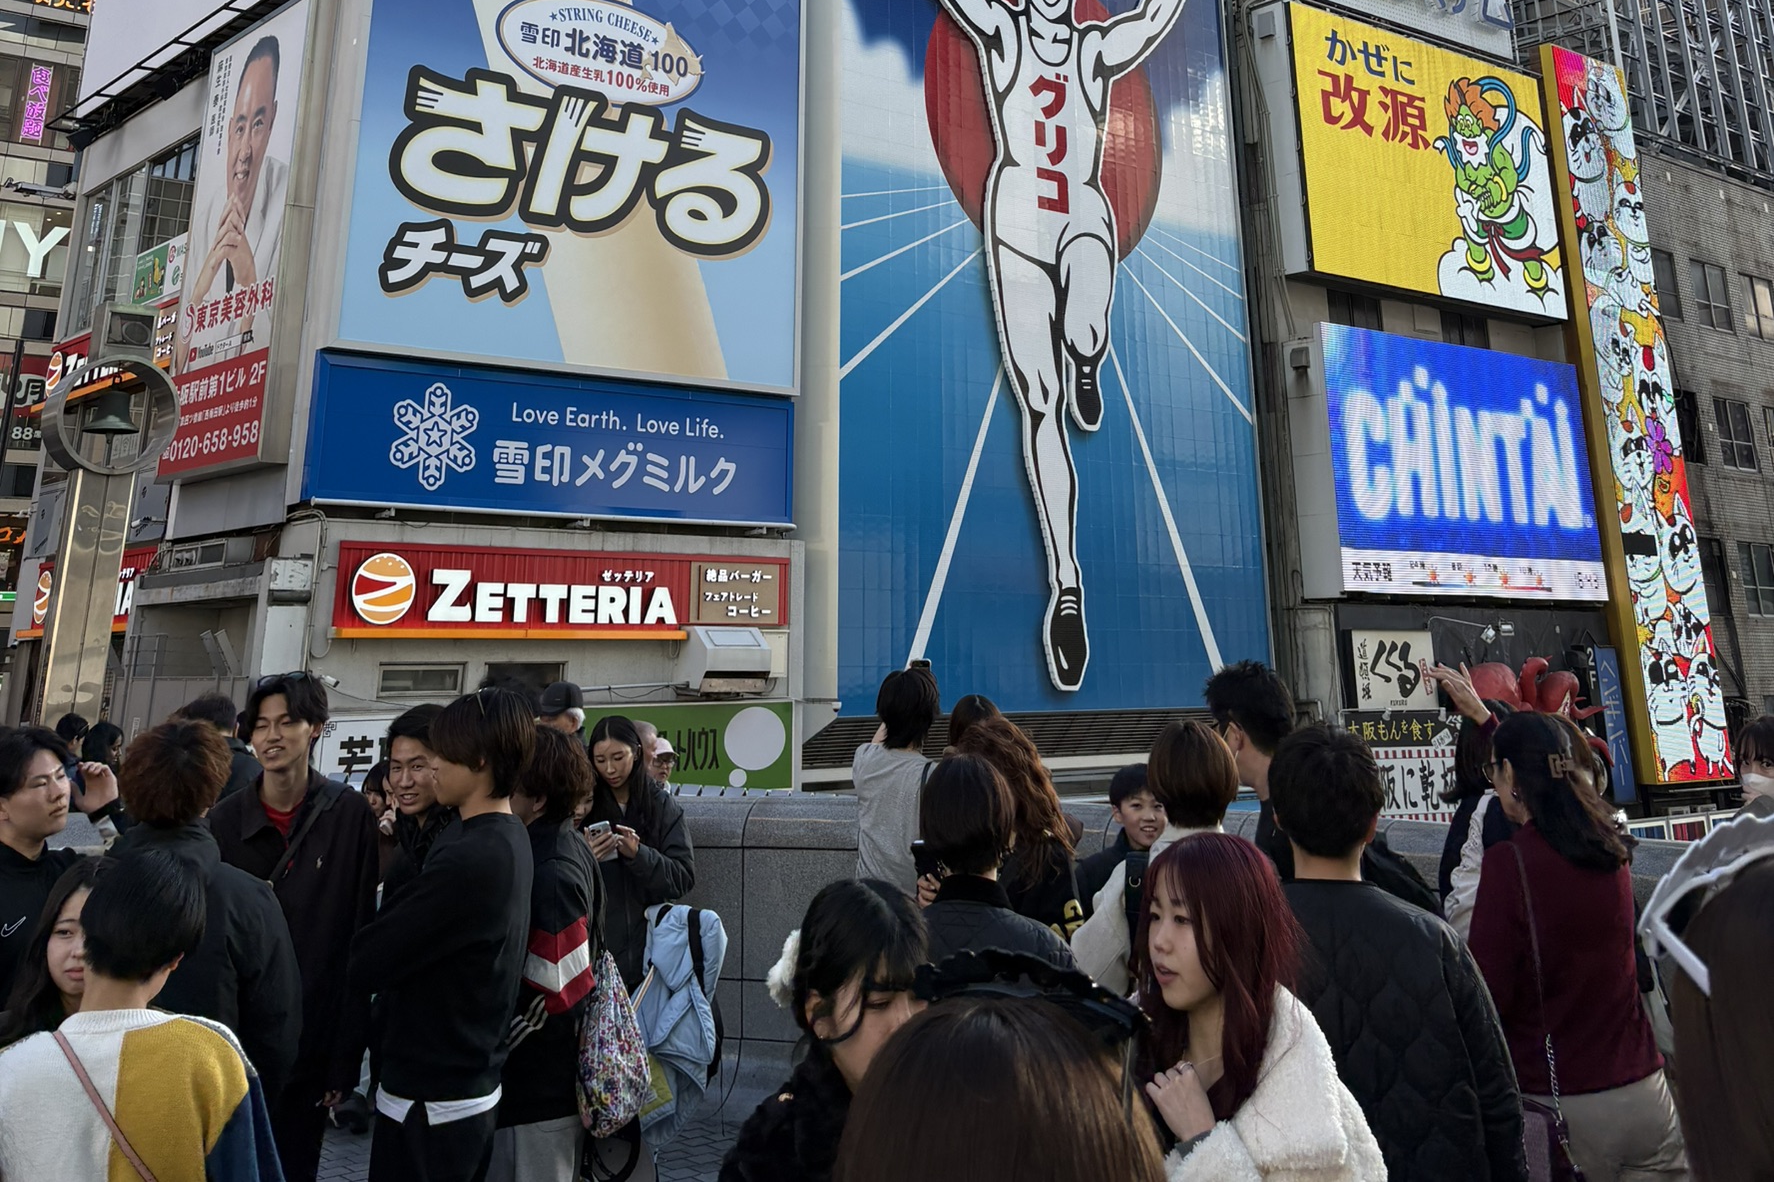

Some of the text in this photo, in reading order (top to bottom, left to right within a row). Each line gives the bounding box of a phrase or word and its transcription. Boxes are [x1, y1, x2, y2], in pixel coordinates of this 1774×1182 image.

[521, 21, 688, 78] 雪印北海道100
[558, 8, 652, 42] STRING CHEESE
[533, 56, 670, 97] 北海道産生乳100%使用
[1325, 29, 1415, 85] かぜに
[1317, 69, 1432, 151] 改源
[394, 70, 767, 251] さける
[1029, 73, 1069, 214] グリコ
[0, 221, 71, 277] Y
[384, 223, 545, 298] チーズ
[195, 277, 274, 333] 東京美容外科
[249, 361, 266, 385] 2F
[511, 402, 725, 439] Love Earth. Love Life.
[493, 440, 737, 495] 雪印メグミルク
[427, 569, 677, 625] ZETTERIA
[602, 570, 655, 584] ゼッテリア
[705, 592, 759, 603] フェアトレード
[706, 569, 772, 583] 絶品バーガー
[727, 605, 772, 618] コーヒー
[1370, 640, 1420, 698] くくる
[1348, 718, 1435, 741] 大阪もんを食す
